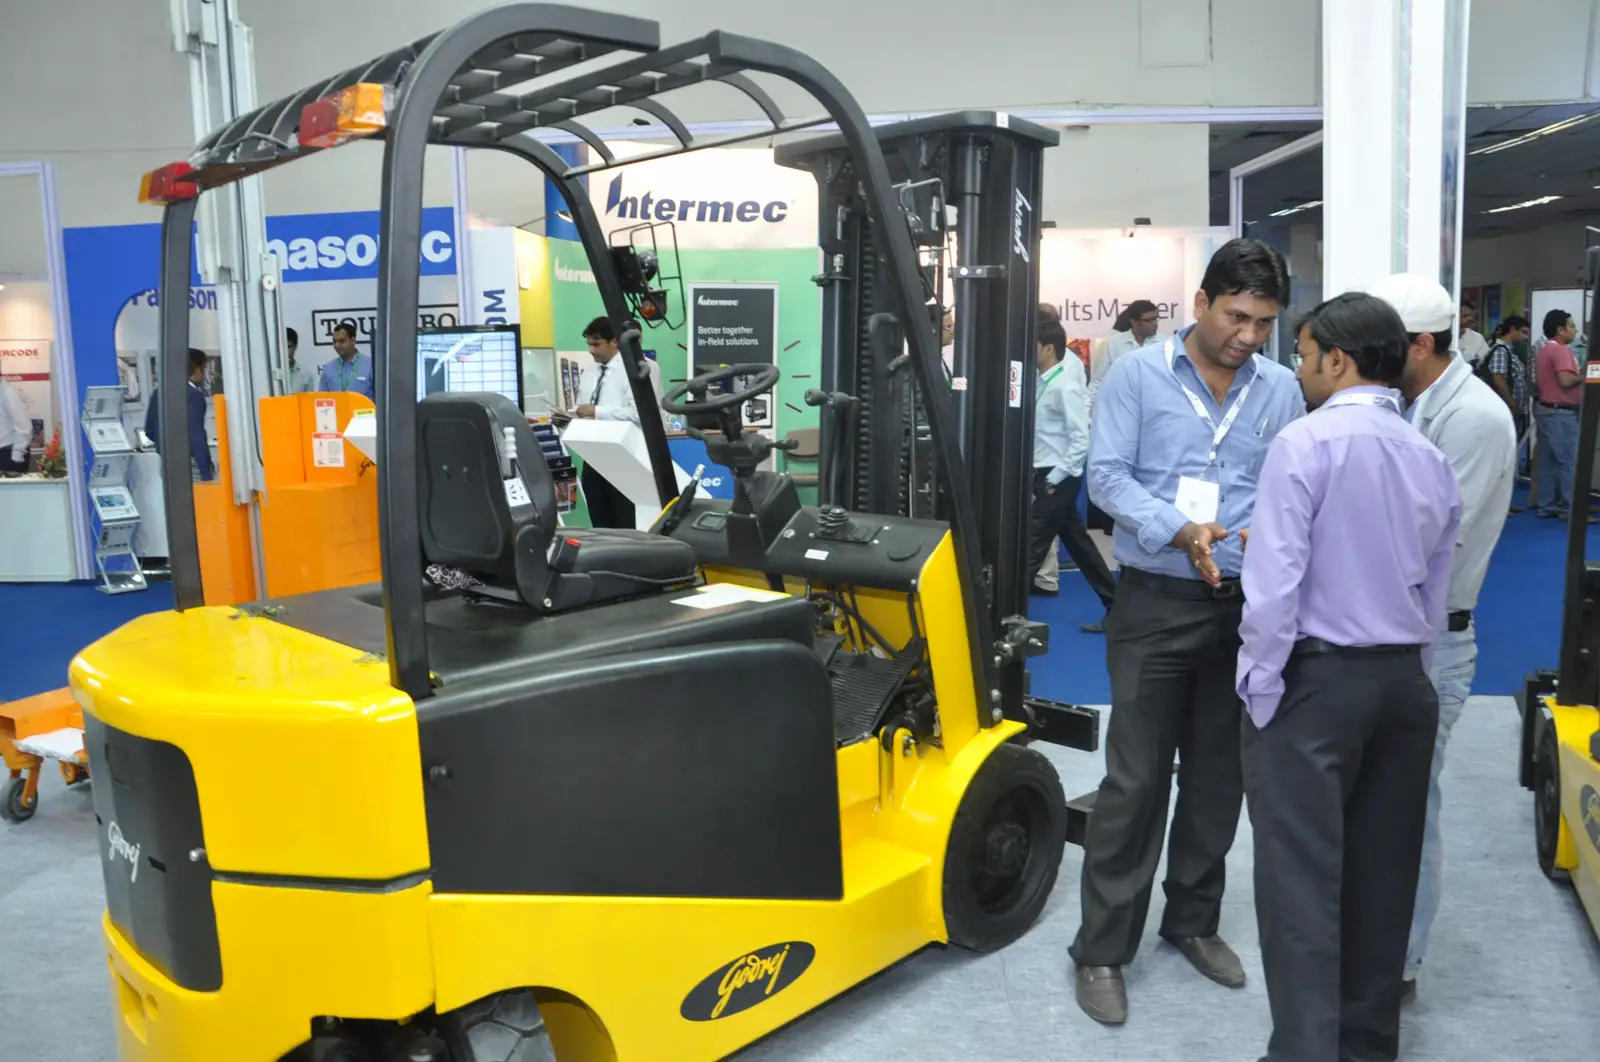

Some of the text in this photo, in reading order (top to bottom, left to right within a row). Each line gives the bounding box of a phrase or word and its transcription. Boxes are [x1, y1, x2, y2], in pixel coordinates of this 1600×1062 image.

[605, 172, 788, 222] Intermec
[698, 295, 738, 306] Intermec
[698, 326, 754, 336] Better together
[725, 337, 758, 346] solutions
[108, 821, 141, 883] Godrej
[711, 944, 790, 1018] Godrej
